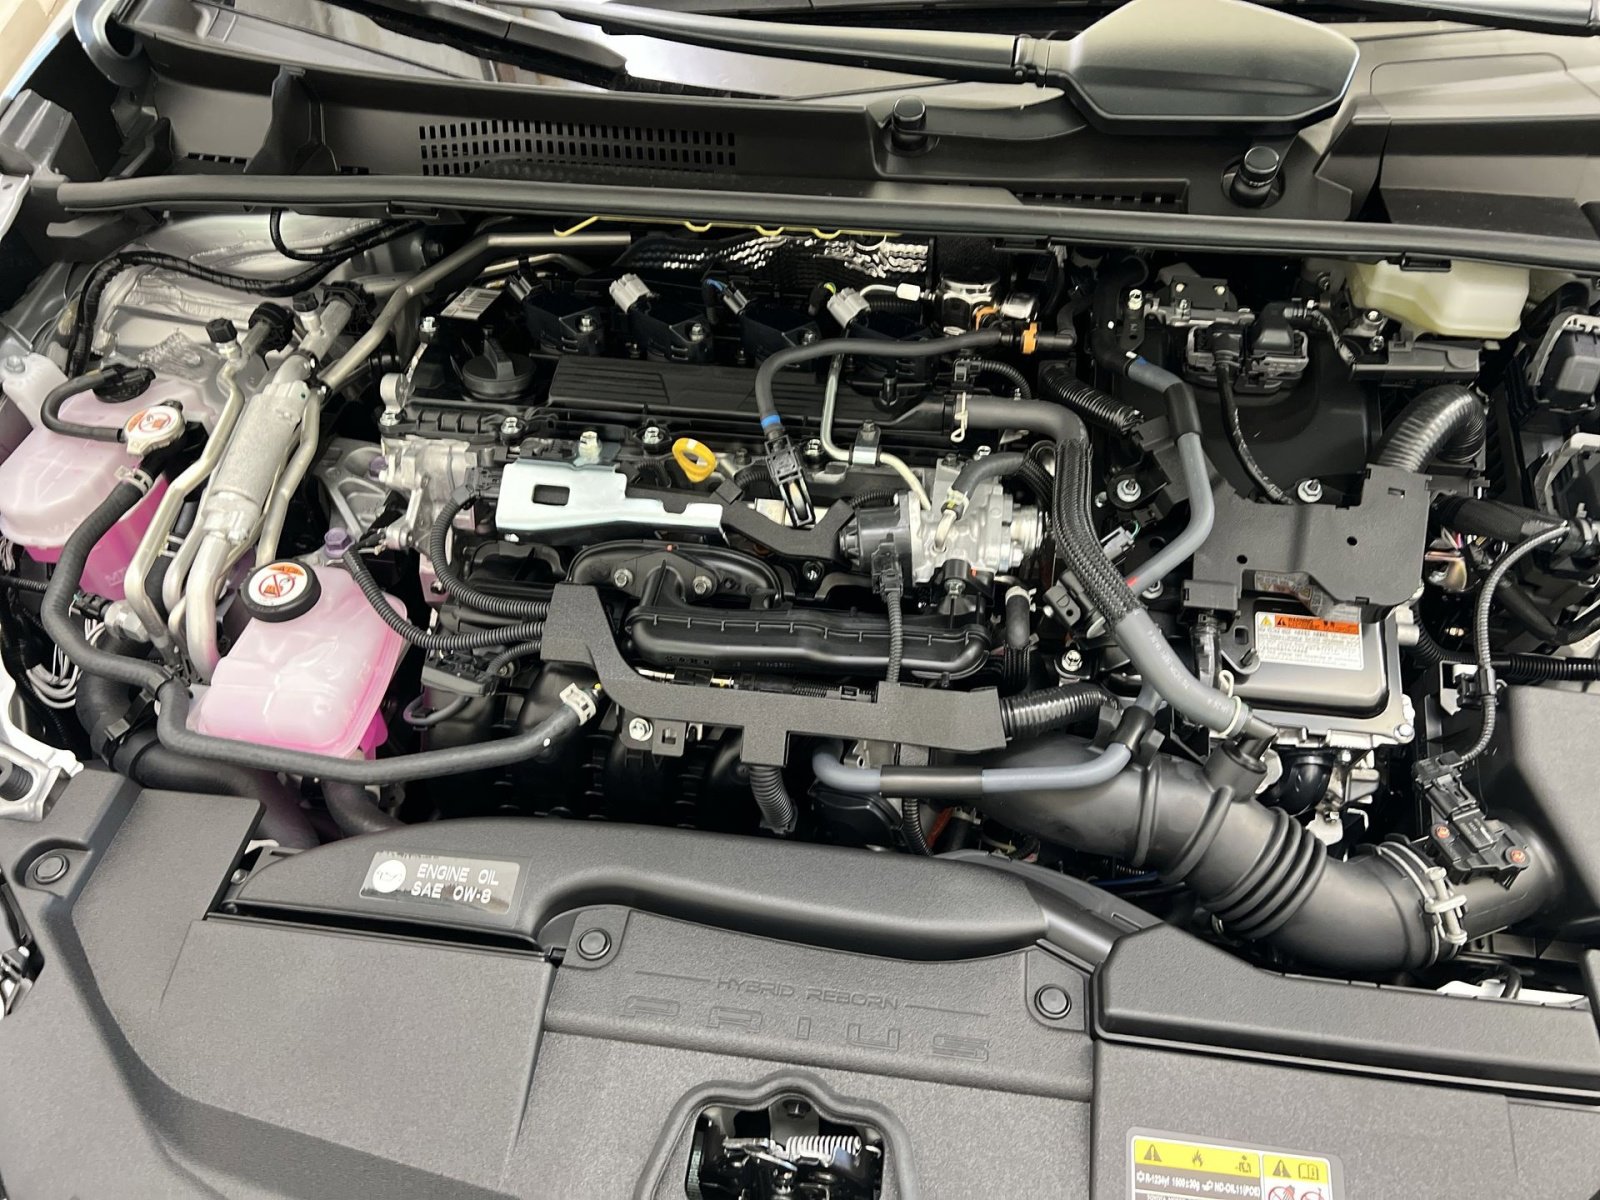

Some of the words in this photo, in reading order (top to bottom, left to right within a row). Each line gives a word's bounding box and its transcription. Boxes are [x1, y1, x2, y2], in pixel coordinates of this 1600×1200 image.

[416, 863, 470, 883] ENGINE
[478, 869, 499, 886] OIL
[411, 881, 444, 898] SAE
[453, 886, 491, 903] 0W-8
[716, 979, 795, 999] HYBRID
[806, 986, 898, 1010] REBORN
